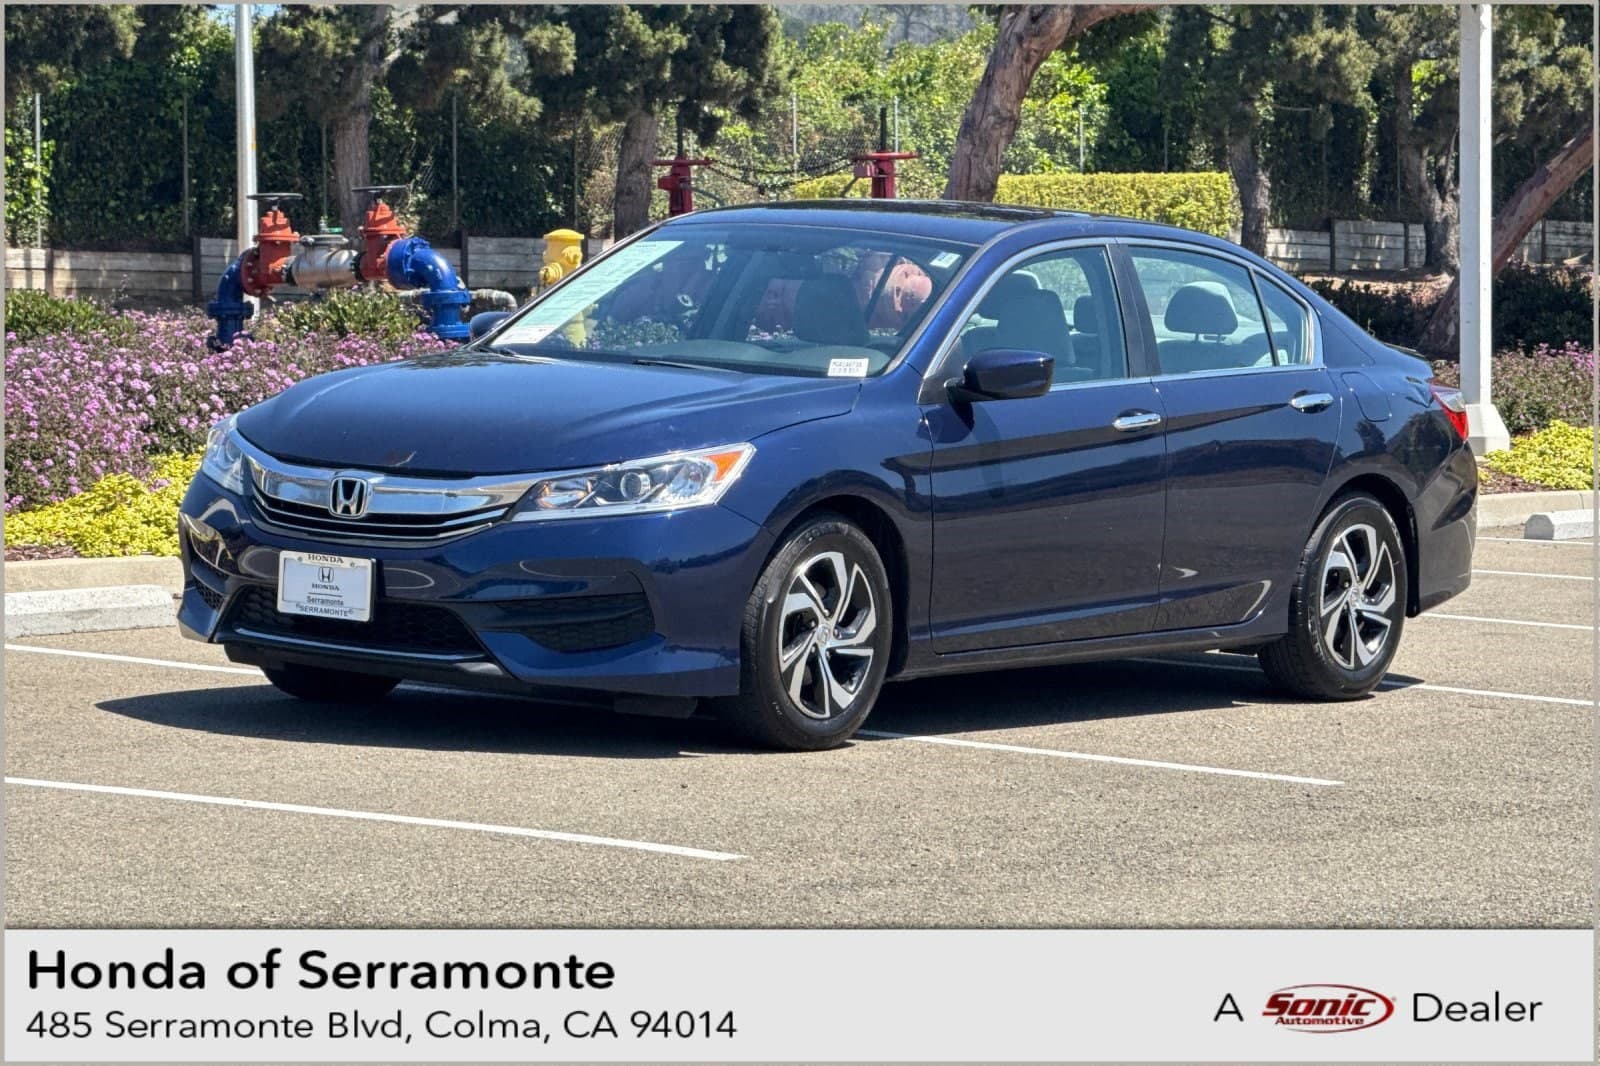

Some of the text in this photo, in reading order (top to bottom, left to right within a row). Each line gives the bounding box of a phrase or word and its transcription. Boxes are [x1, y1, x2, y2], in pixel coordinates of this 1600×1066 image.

[307, 553, 345, 564] HONDA
[311, 583, 340, 592] HONDA
[306, 595, 344, 606] Serramonte
